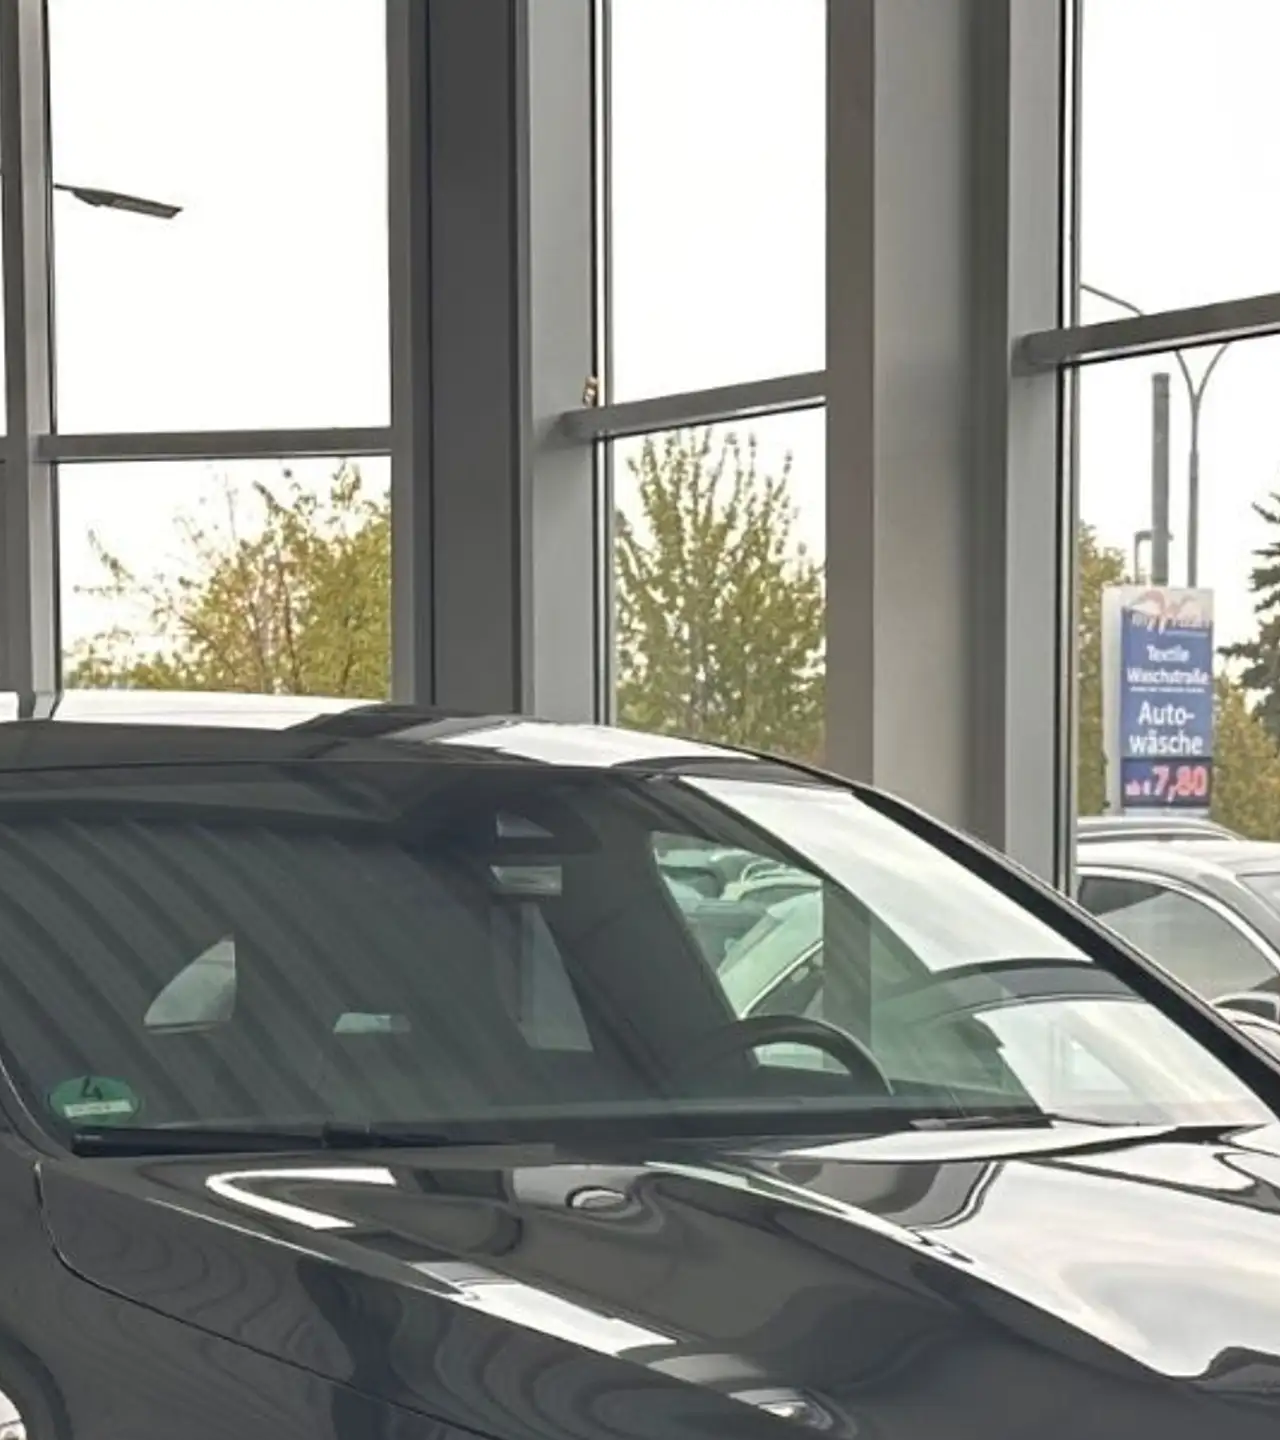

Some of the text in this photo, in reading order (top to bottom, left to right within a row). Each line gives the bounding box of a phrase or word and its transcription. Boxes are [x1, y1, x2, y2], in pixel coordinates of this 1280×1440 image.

[1147, 644, 1190, 662] Textile
[1127, 666, 1209, 685] Waschstraße
[1137, 700, 1195, 725] Auto-
[1129, 729, 1203, 755] wäsche
[1152, 765, 1207, 803] 7,80
